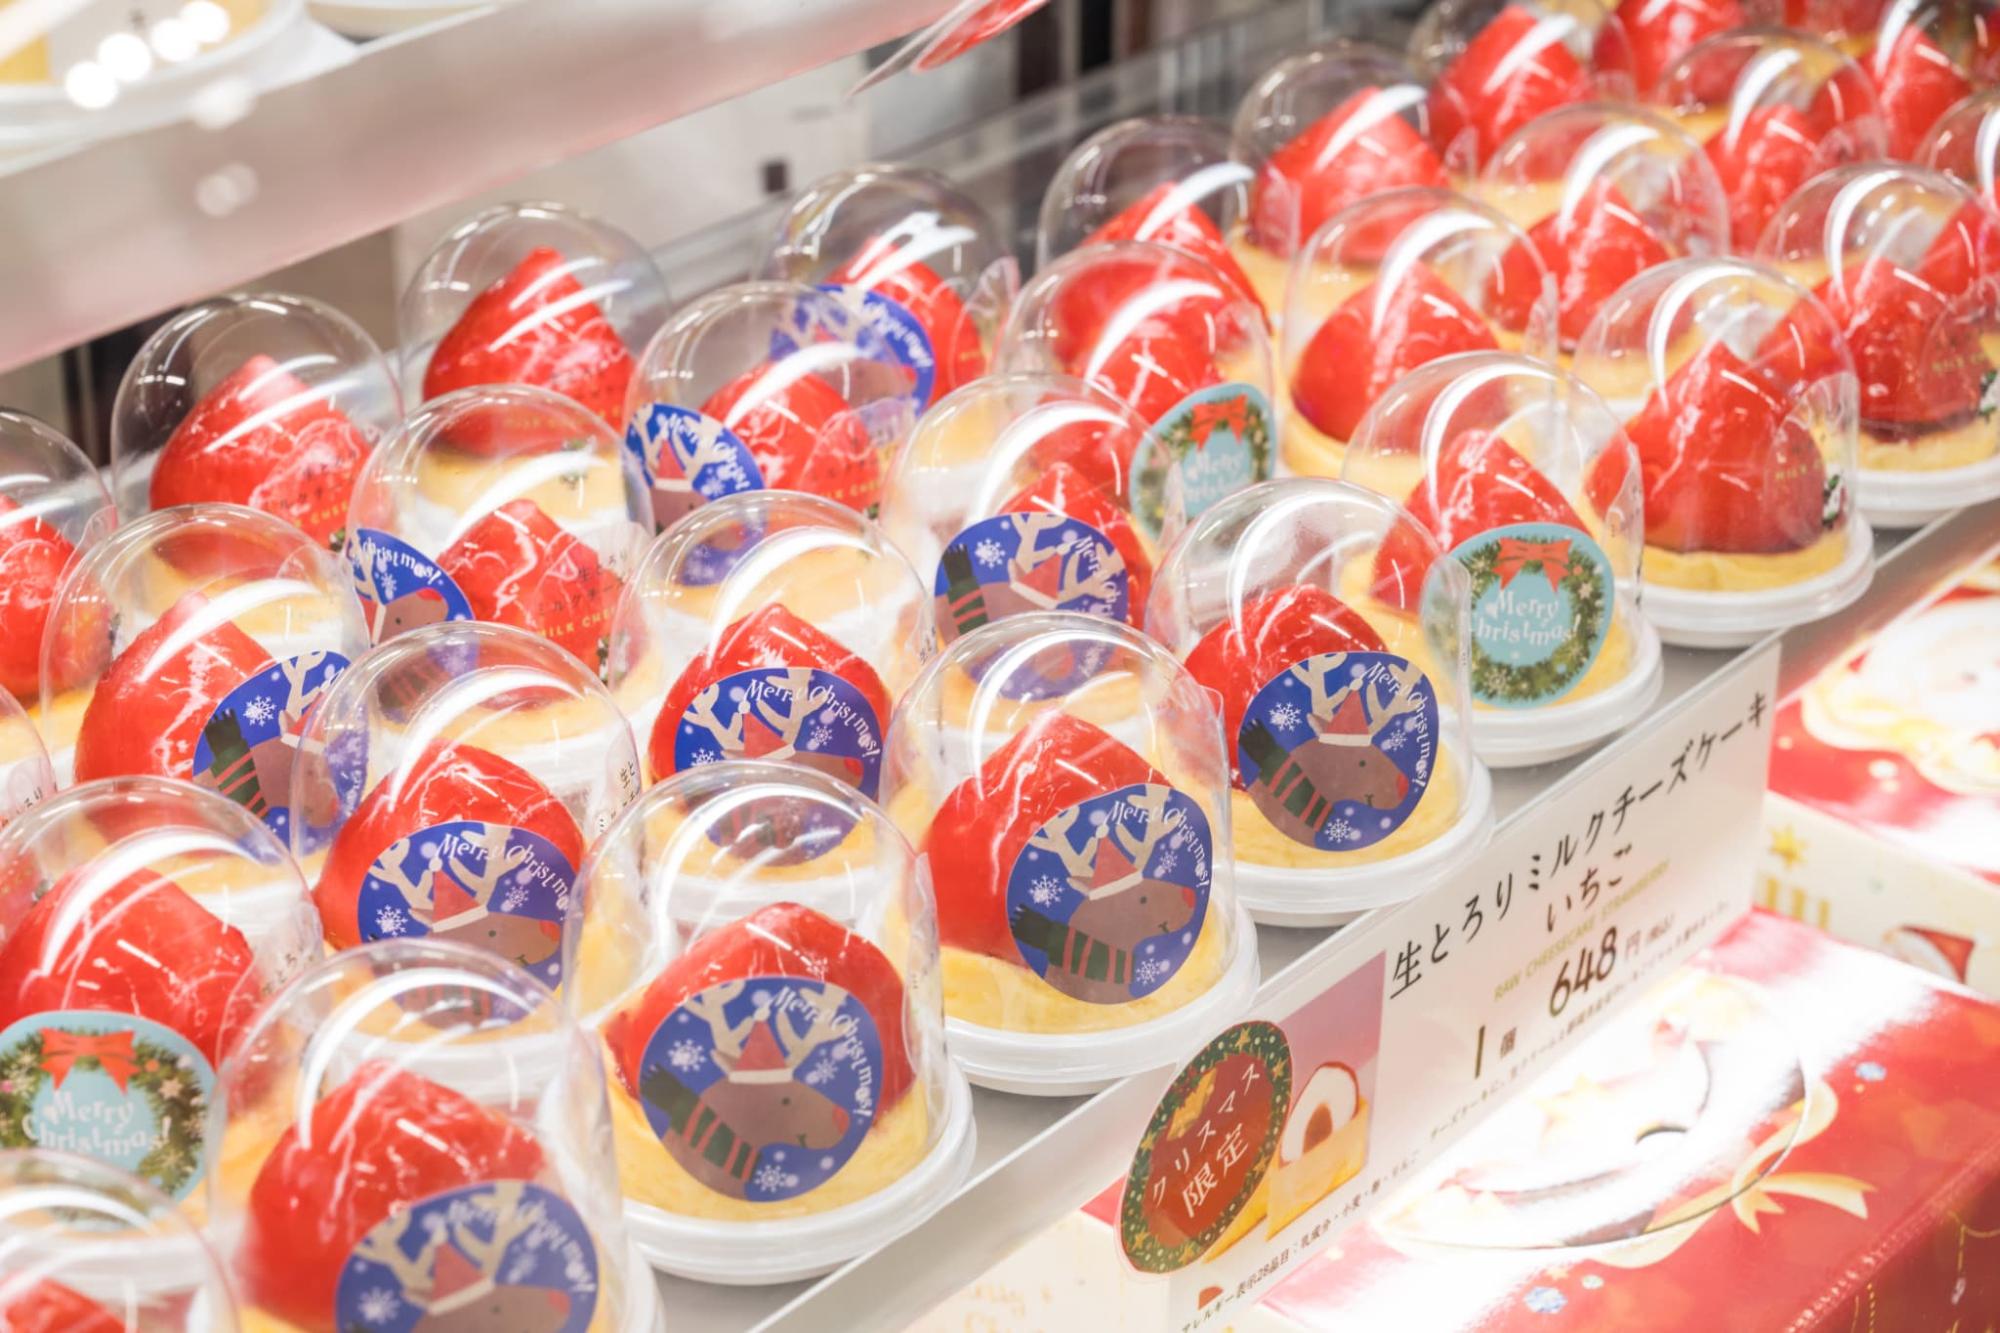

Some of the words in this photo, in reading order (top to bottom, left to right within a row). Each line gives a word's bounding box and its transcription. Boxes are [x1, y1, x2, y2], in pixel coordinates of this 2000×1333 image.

[1468, 613, 1581, 645] hristmas!
[1485, 591, 1560, 628] Merry
[808, 684, 881, 758] Christmas!
[1407, 691, 1432, 788] Christmas!
[505, 844, 570, 911] Christma
[1163, 807, 1210, 888] Christmas!
[1390, 692, 1767, 1000] 生とろりミルクチーズケーキ
[1547, 844, 1632, 933] いちご
[831, 1013, 873, 1117] Christmas!
[21, 1115, 172, 1156] Christmas!
[44, 1090, 135, 1134] Merry
[1153, 1063, 1260, 1208] クリスマス
[1183, 1123, 1249, 1218] 限定
